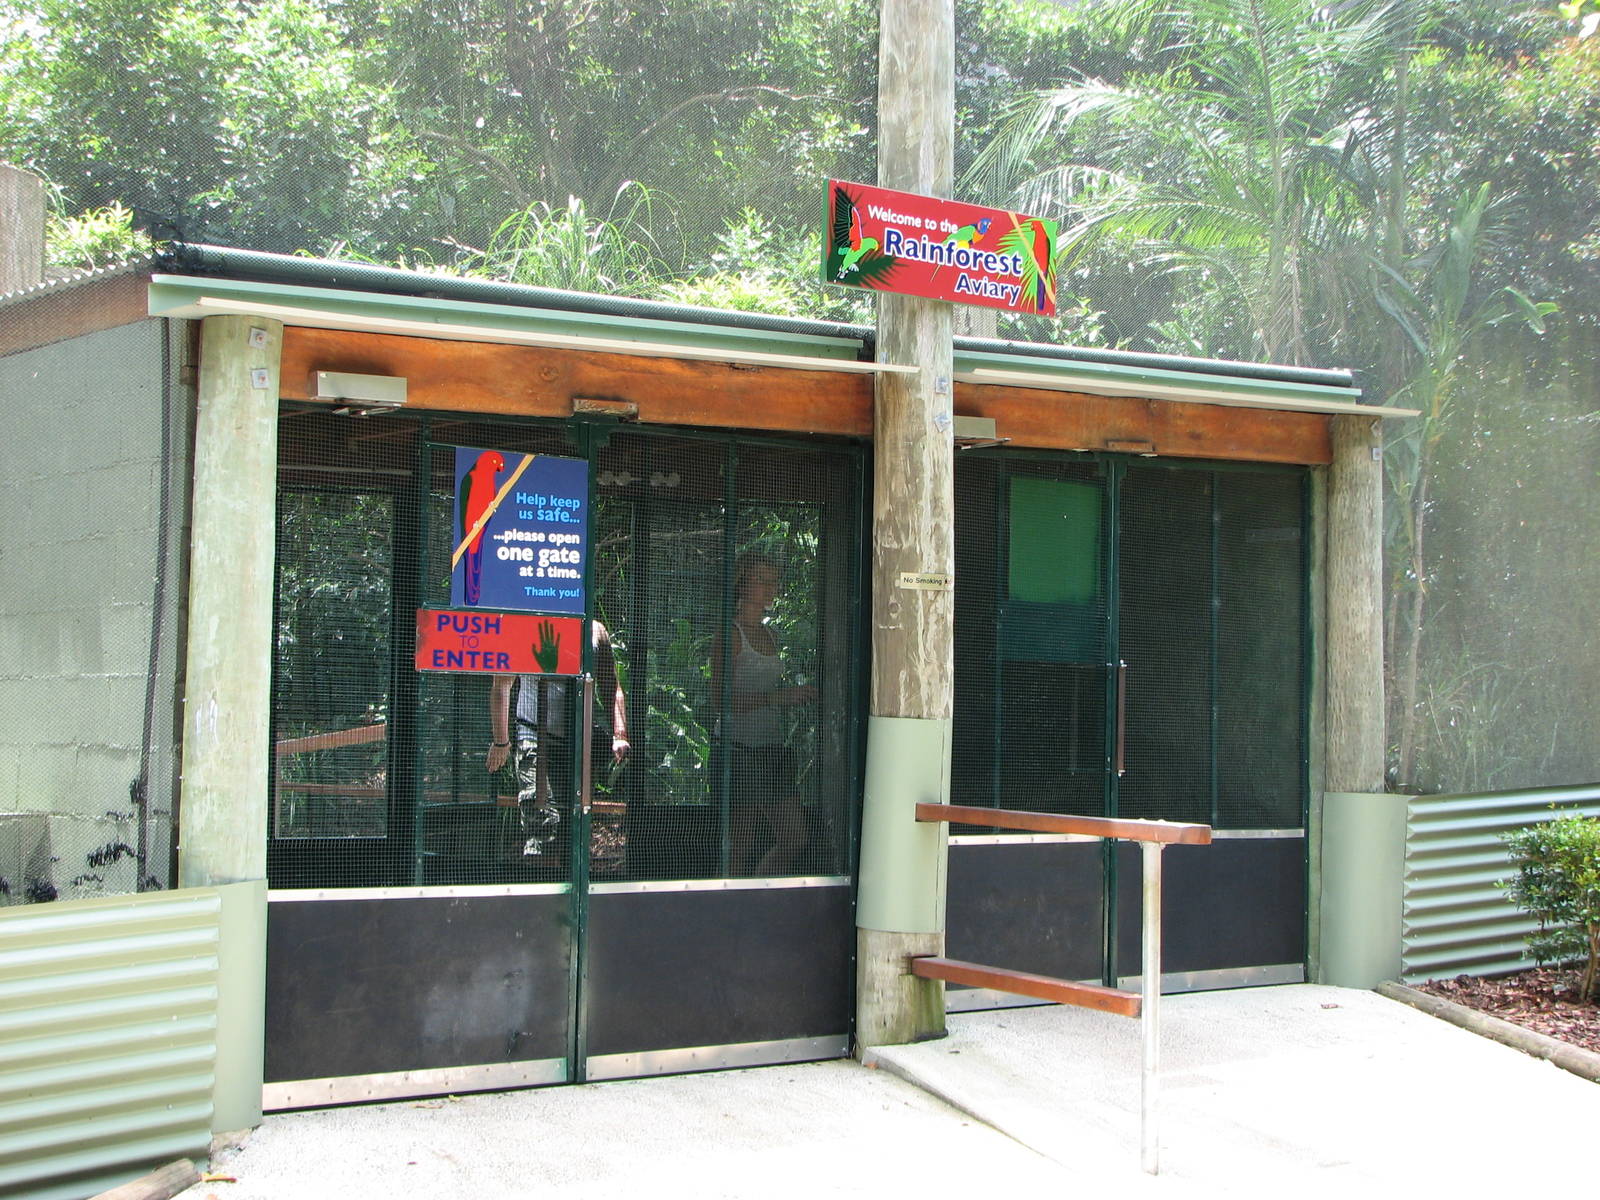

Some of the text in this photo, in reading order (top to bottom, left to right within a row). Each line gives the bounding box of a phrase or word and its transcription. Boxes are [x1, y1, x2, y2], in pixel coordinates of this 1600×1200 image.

[868, 205, 958, 234] Welcome to the
[884, 228, 1023, 276] Rainforest
[954, 272, 1021, 306] Aviary
[515, 492, 581, 511] Help keep
[519, 507, 580, 523] us safe...
[493, 529, 580, 546] ...please open
[497, 546, 580, 567] one gate
[519, 565, 581, 579] at a time.
[916, 577, 942, 586] Smoking
[524, 586, 580, 599] Thank you!
[437, 614, 500, 634] PUSH
[460, 635, 479, 649] TO
[433, 650, 511, 669] ENTER
